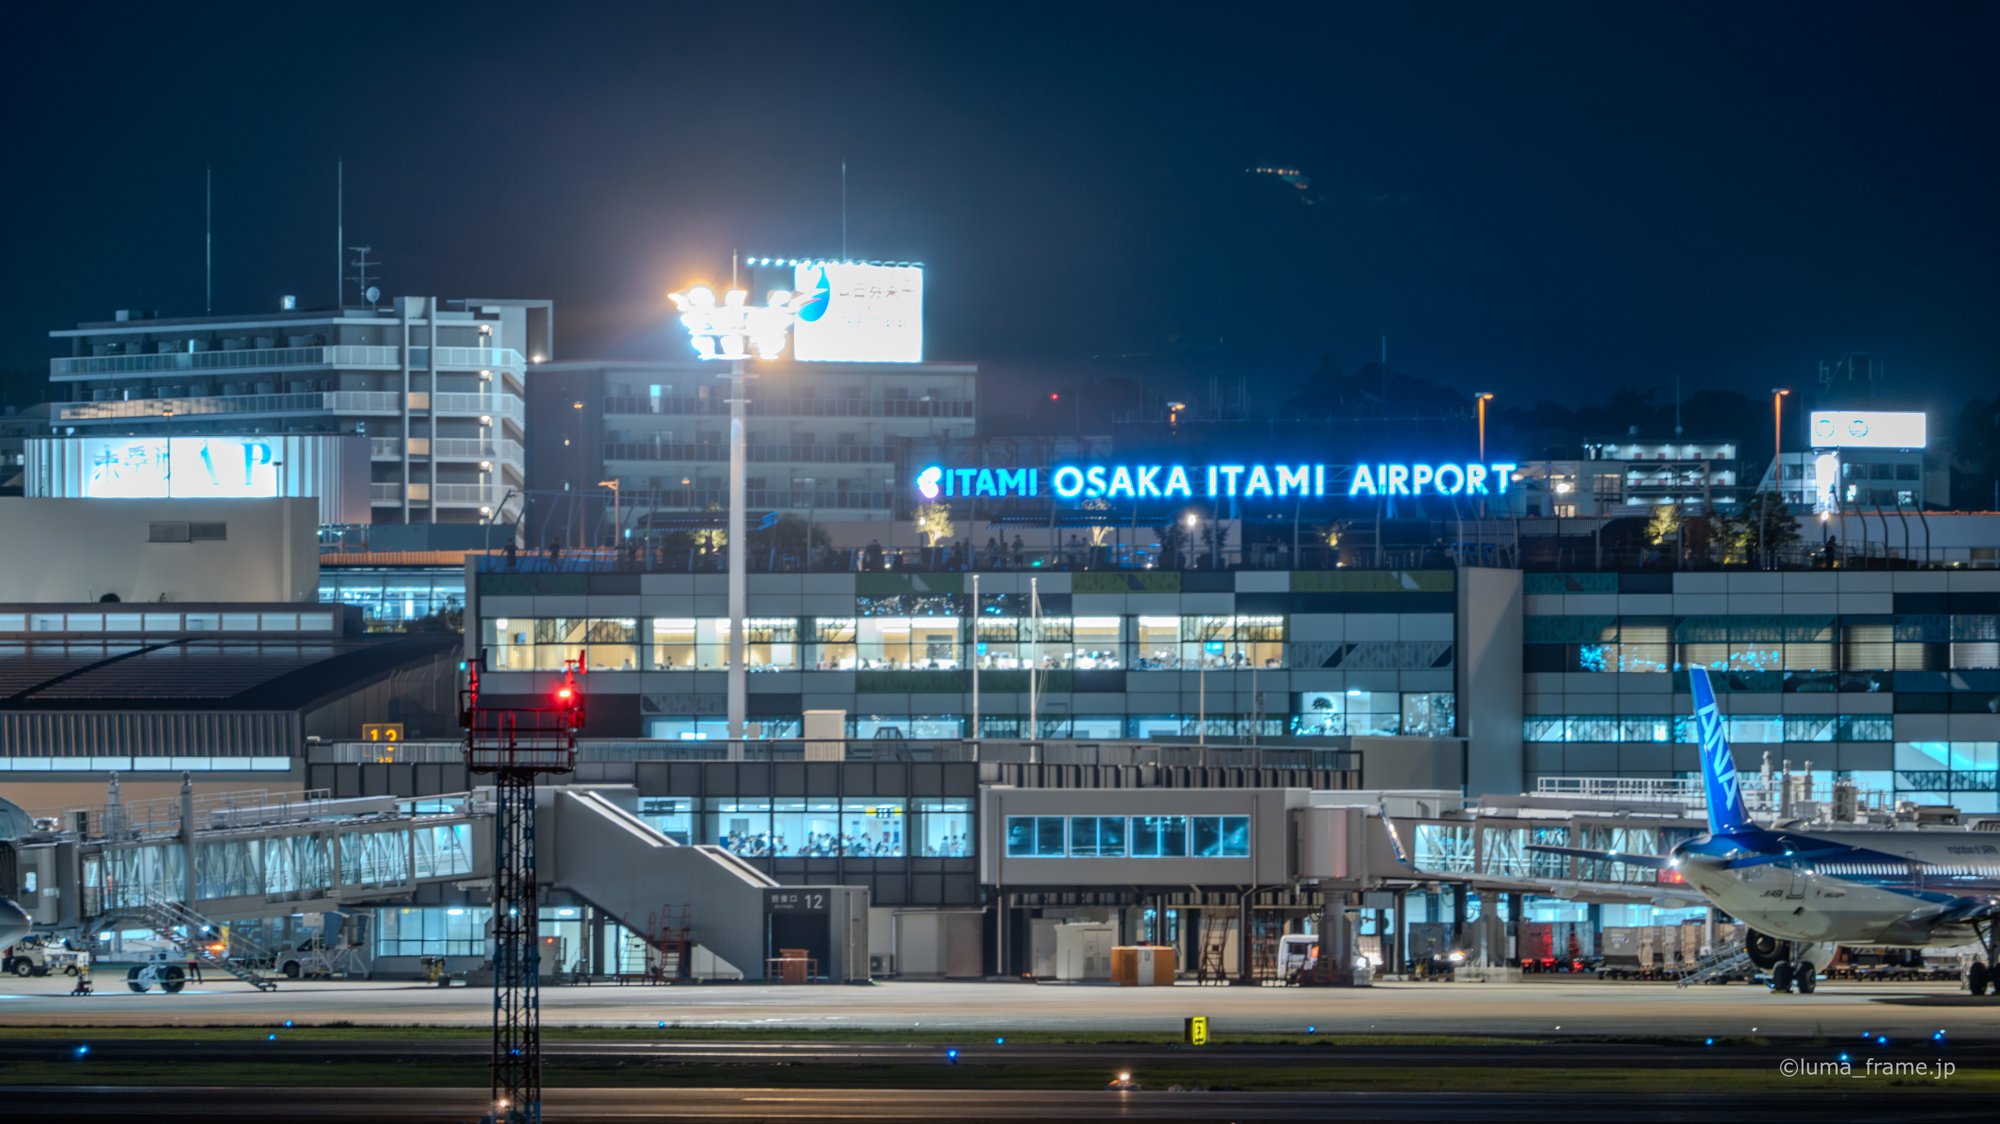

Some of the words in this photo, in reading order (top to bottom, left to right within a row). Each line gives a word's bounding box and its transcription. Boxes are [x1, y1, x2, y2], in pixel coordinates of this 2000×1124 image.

[945, 468, 1038, 496] ITAMI
[1054, 465, 1192, 497] OSAKA
[1208, 464, 1325, 496] ITAMI
[1349, 463, 1517, 495] AIRPORT
[1698, 702, 1737, 811] ANA
[804, 894, 823, 909] 12
